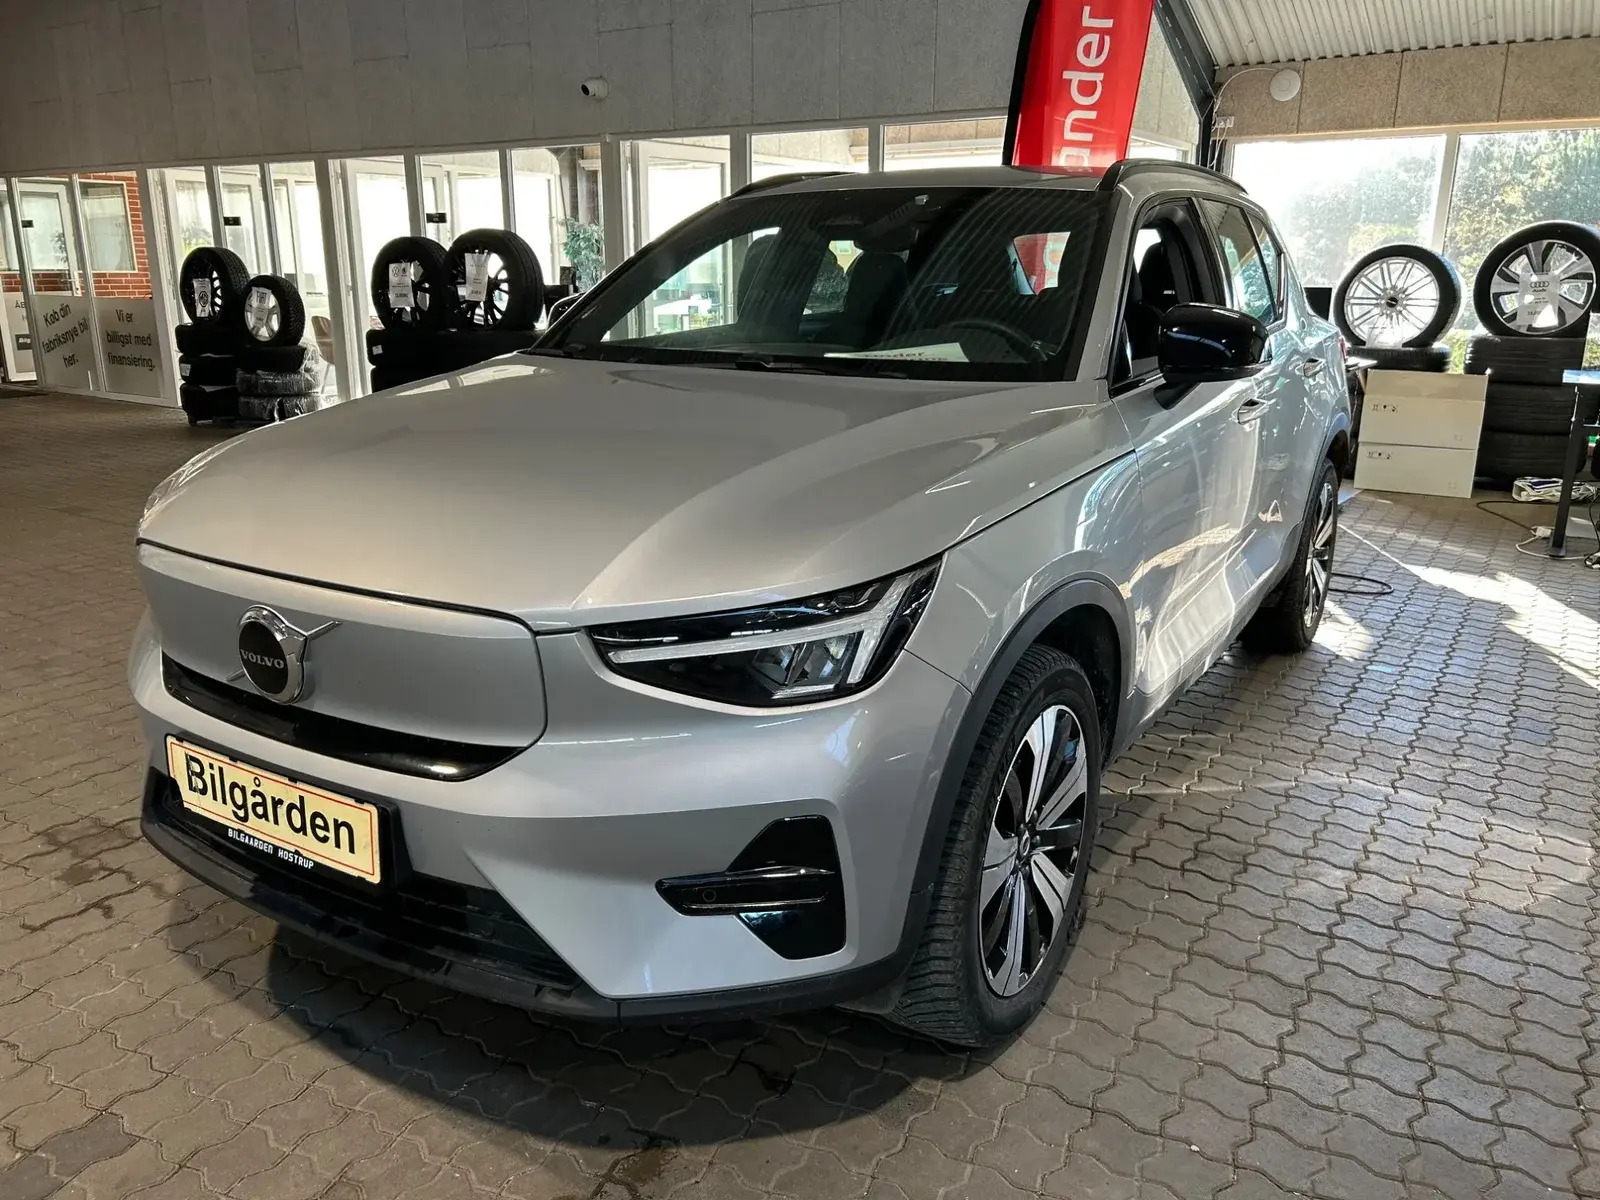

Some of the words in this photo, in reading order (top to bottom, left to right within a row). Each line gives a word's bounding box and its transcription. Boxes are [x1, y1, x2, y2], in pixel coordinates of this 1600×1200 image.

[60, 303, 72, 318] din
[115, 309, 124, 322] Vi
[126, 312, 133, 323] er
[105, 329, 133, 347] billigst
[134, 333, 152, 346] med
[62, 353, 79, 368] her.
[107, 352, 155, 371] finansiering.
[240, 649, 285, 669] VOLVO
[184, 750, 356, 855] Bilgården
[227, 828, 274, 854] BILGAARDEN
[278, 848, 314, 870] HOSTRUP
